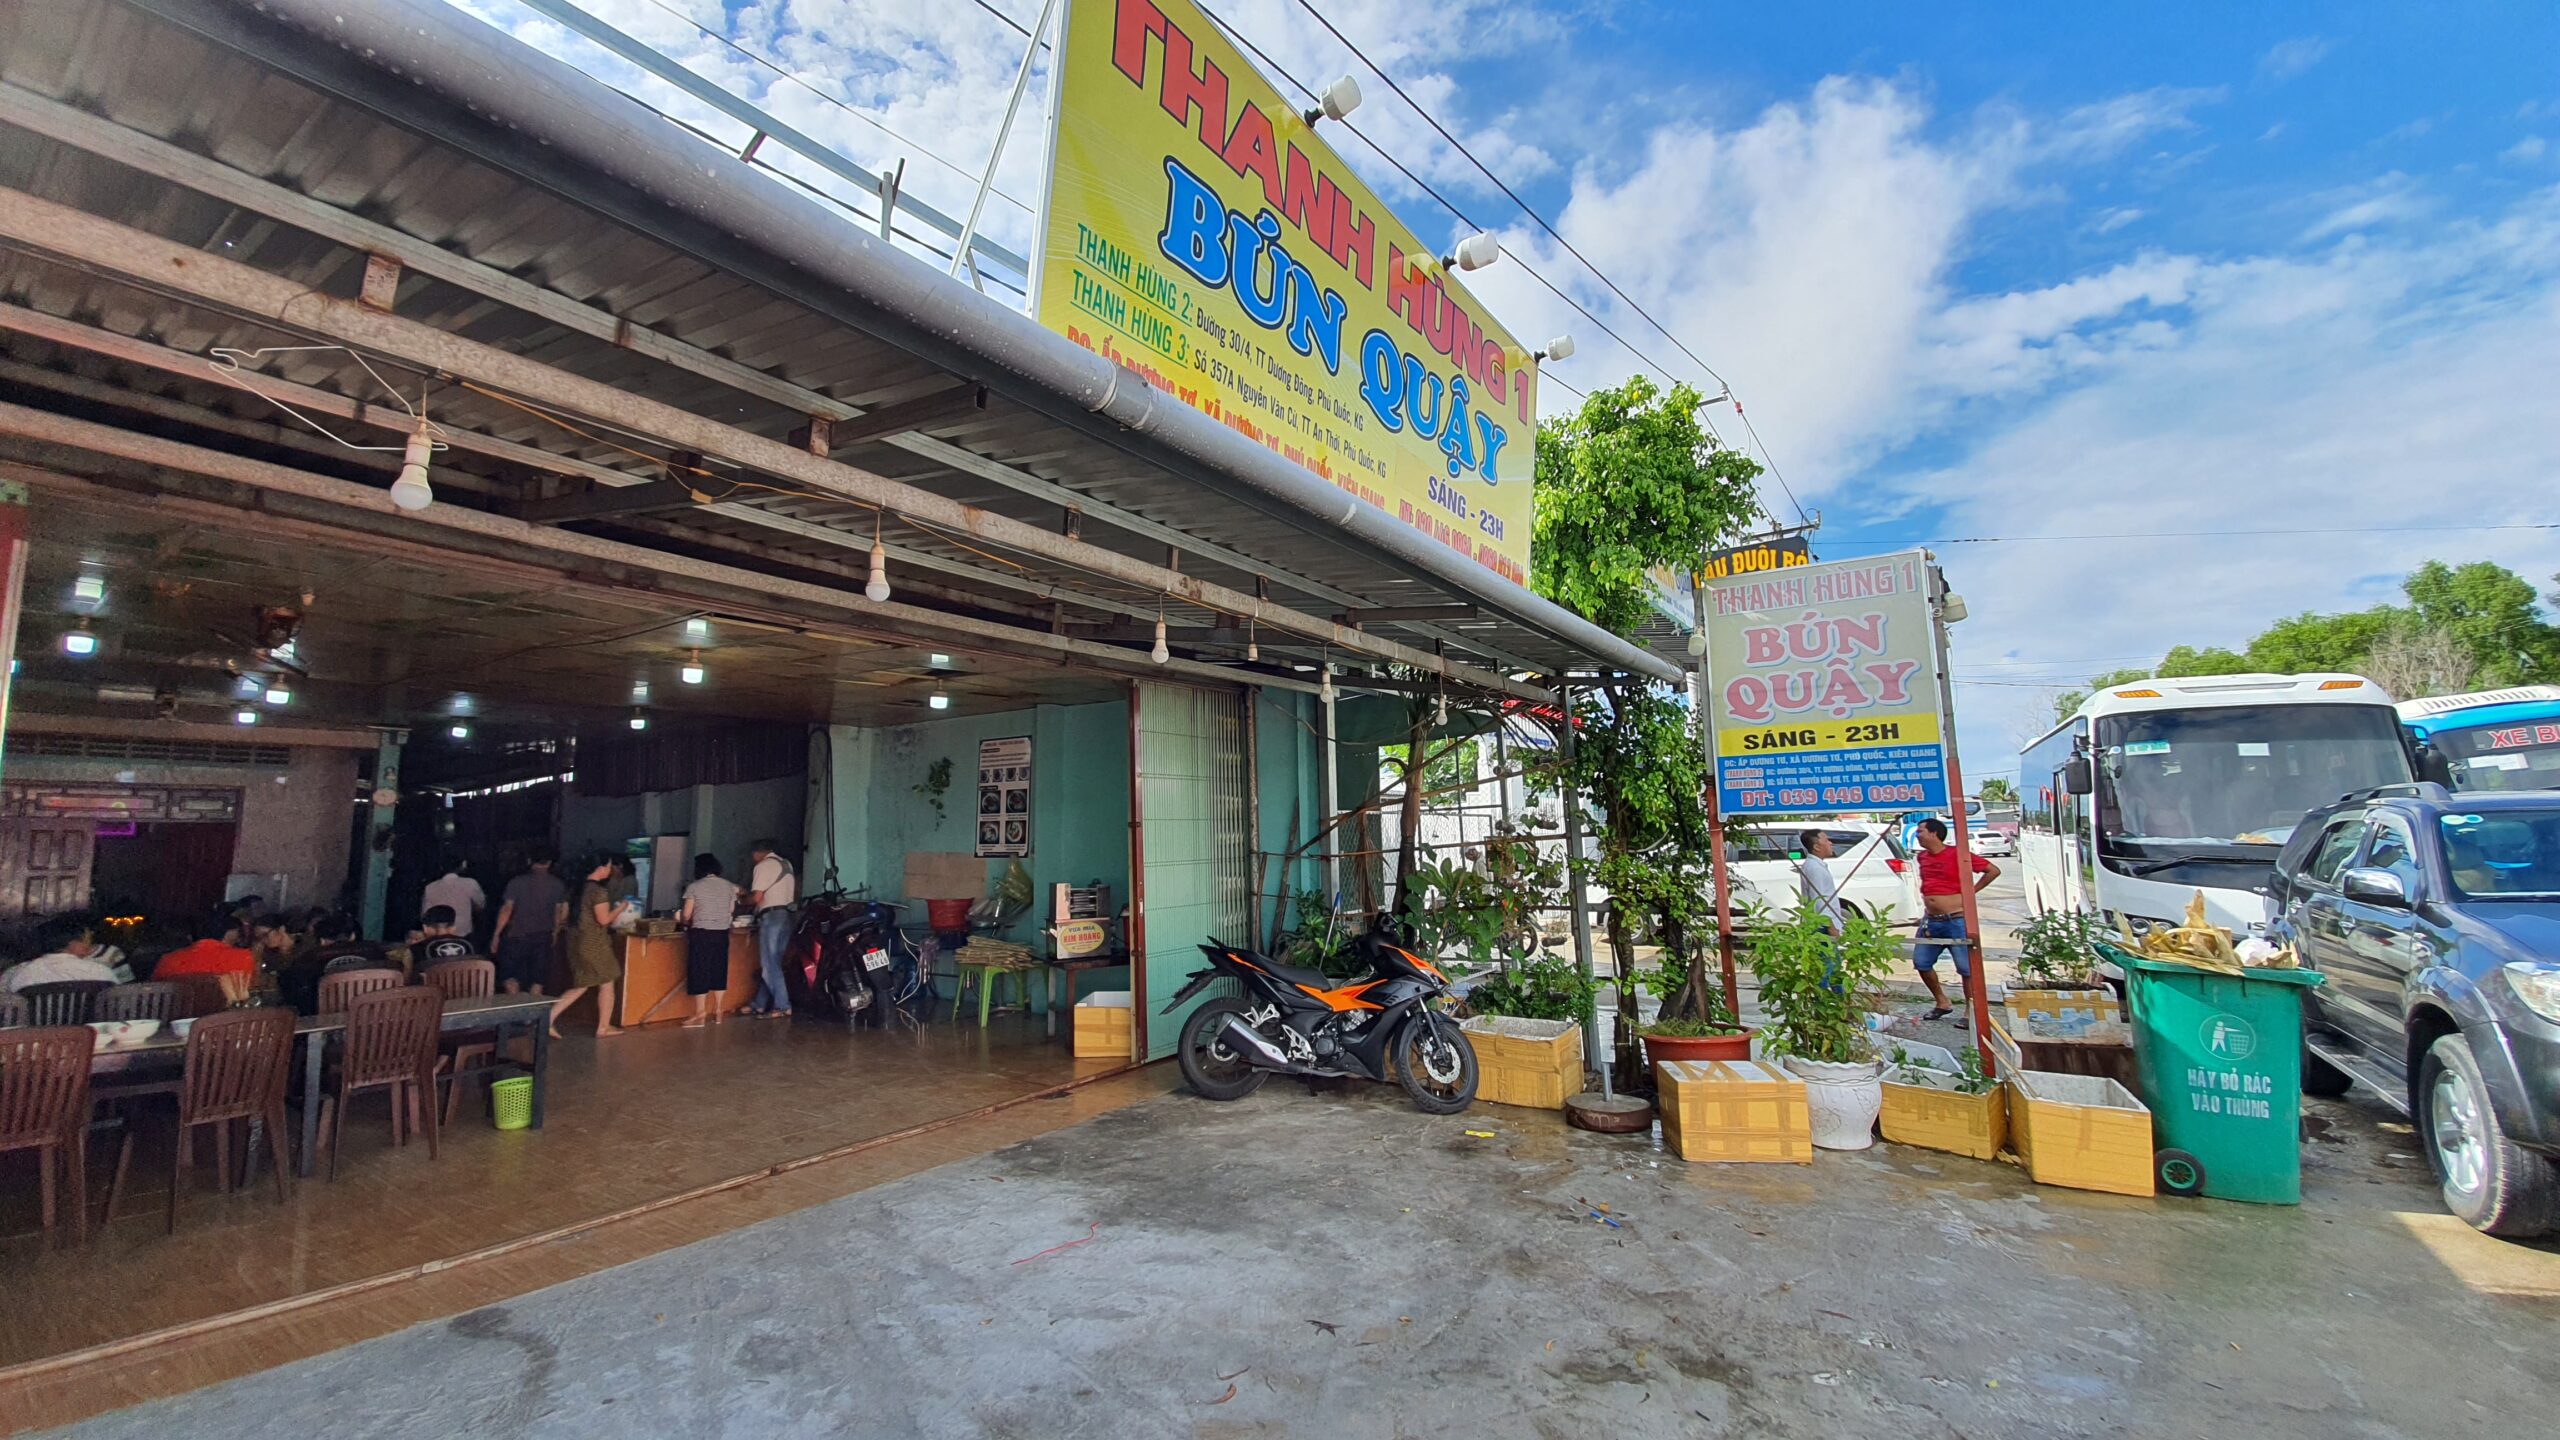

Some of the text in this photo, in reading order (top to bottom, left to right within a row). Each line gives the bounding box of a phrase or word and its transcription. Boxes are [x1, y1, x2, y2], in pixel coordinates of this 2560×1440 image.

[1112, 0, 1529, 427] THANH HÙNG 1
[1077, 223, 1363, 432] THANH HÙNG 2: Đường 30/4, TT Dương Đông, Phú Quốc, KG
[1158, 155, 1507, 486] BÚN QUẬY
[1073, 269, 1386, 479] THANH HÙNG 3: Số 357A Nguyễn Văn Cừ, TT An Thới, Phú Quốc, KG
[1428, 476, 1466, 520] SÁNG
[1479, 509, 1503, 541] 23H
[1731, 544, 1777, 574] ĐUÔI
[1712, 578, 1805, 615] THANH
[1813, 566, 1895, 601] HÙNG
[1902, 560, 1915, 590] 1
[1743, 611, 1884, 664] BÚN
[1725, 657, 1916, 721] QUẬY
[1744, 730, 1816, 750] SÁNG
[1845, 723, 1899, 743] 23H
[2488, 727, 2531, 748] XE
[1741, 784, 1924, 807] ĐT: 039 446 0964
[2187, 1066, 2271, 1094] HÃY BỎ RÁC
[2191, 1090, 2270, 1118] VÀO THÙNG
